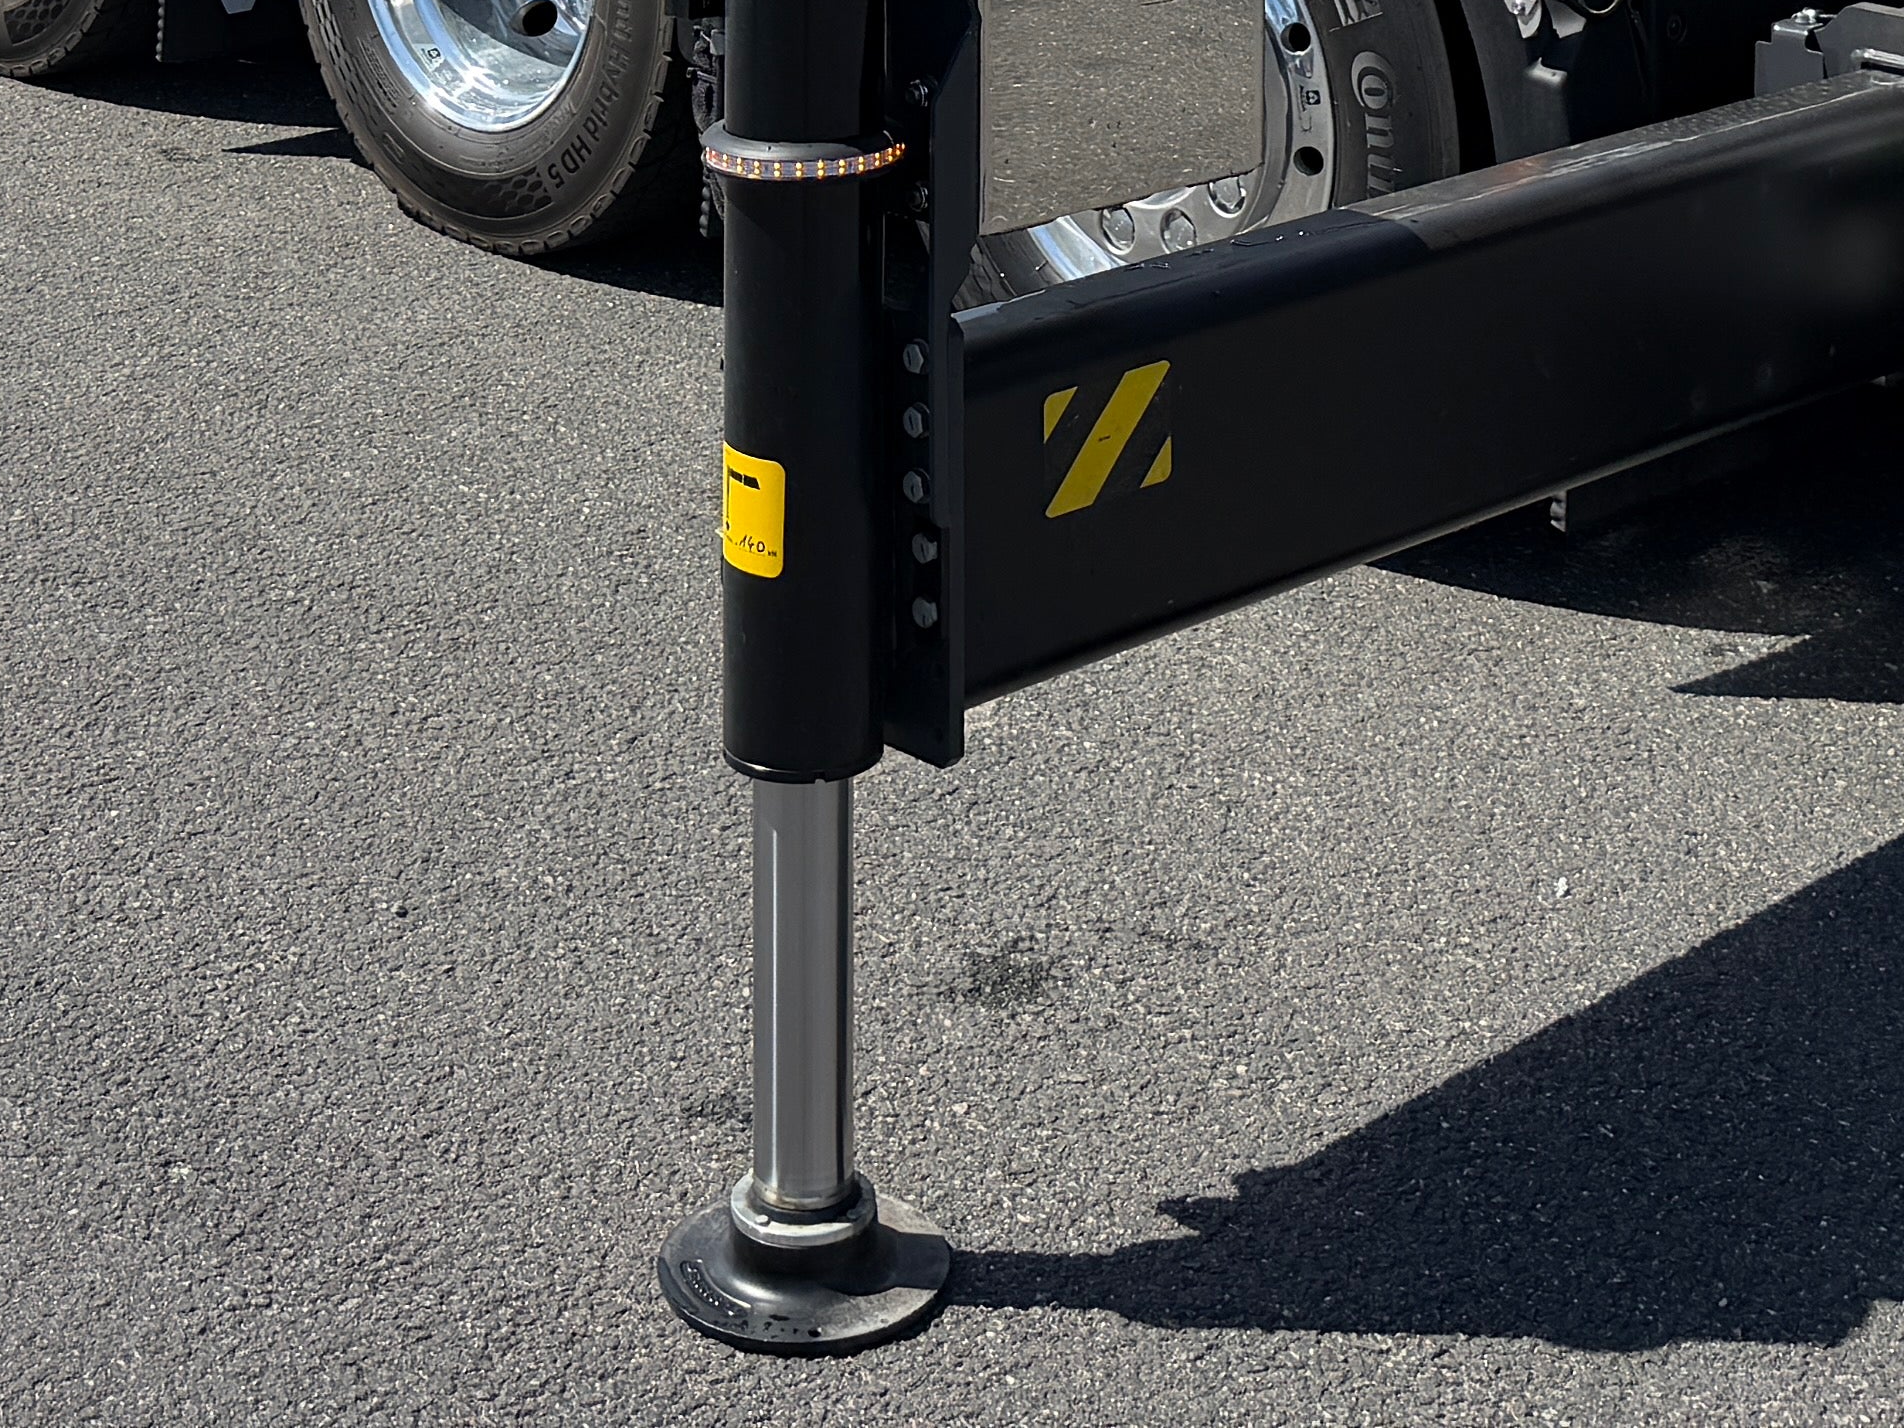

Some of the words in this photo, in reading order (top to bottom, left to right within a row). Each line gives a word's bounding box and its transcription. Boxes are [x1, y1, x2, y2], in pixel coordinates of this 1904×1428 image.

[585, 44, 632, 142] Hybrid
[560, 139, 594, 184] HD
[550, 168, 566, 189] 5
[740, 534, 766, 553] 140
